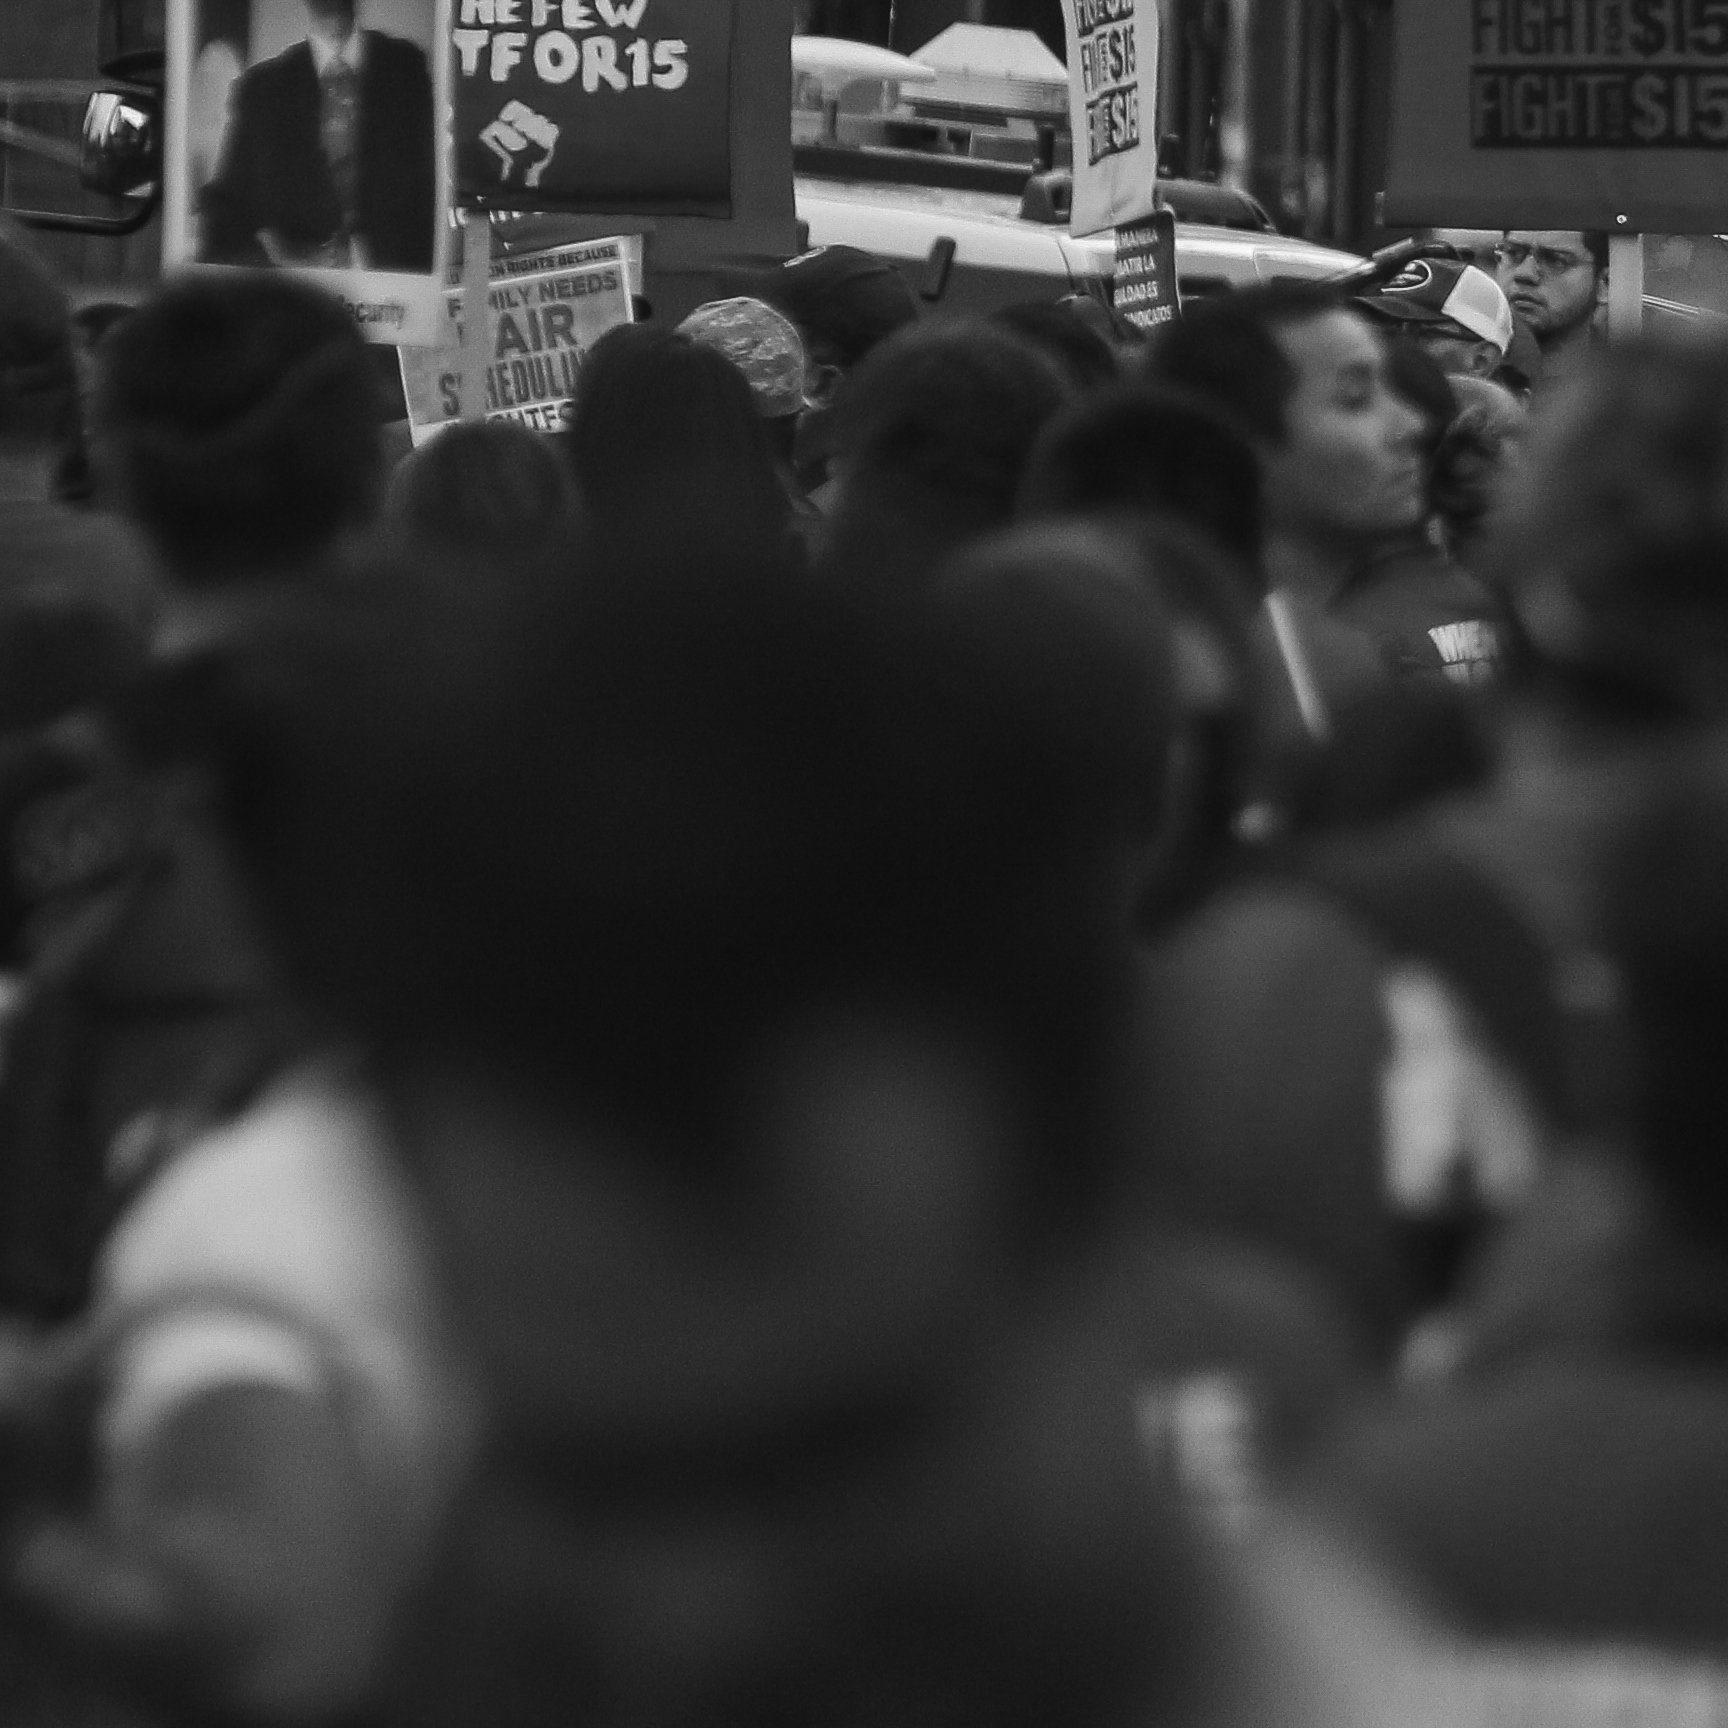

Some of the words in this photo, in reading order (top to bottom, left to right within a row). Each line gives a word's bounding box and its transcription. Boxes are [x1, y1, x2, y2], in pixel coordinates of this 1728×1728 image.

[452, 28, 688, 93] TFOR15
[1473, 75, 1626, 139] FIGHT
[539, 271, 617, 302] NEEDS
[496, 303, 579, 358] AIR
